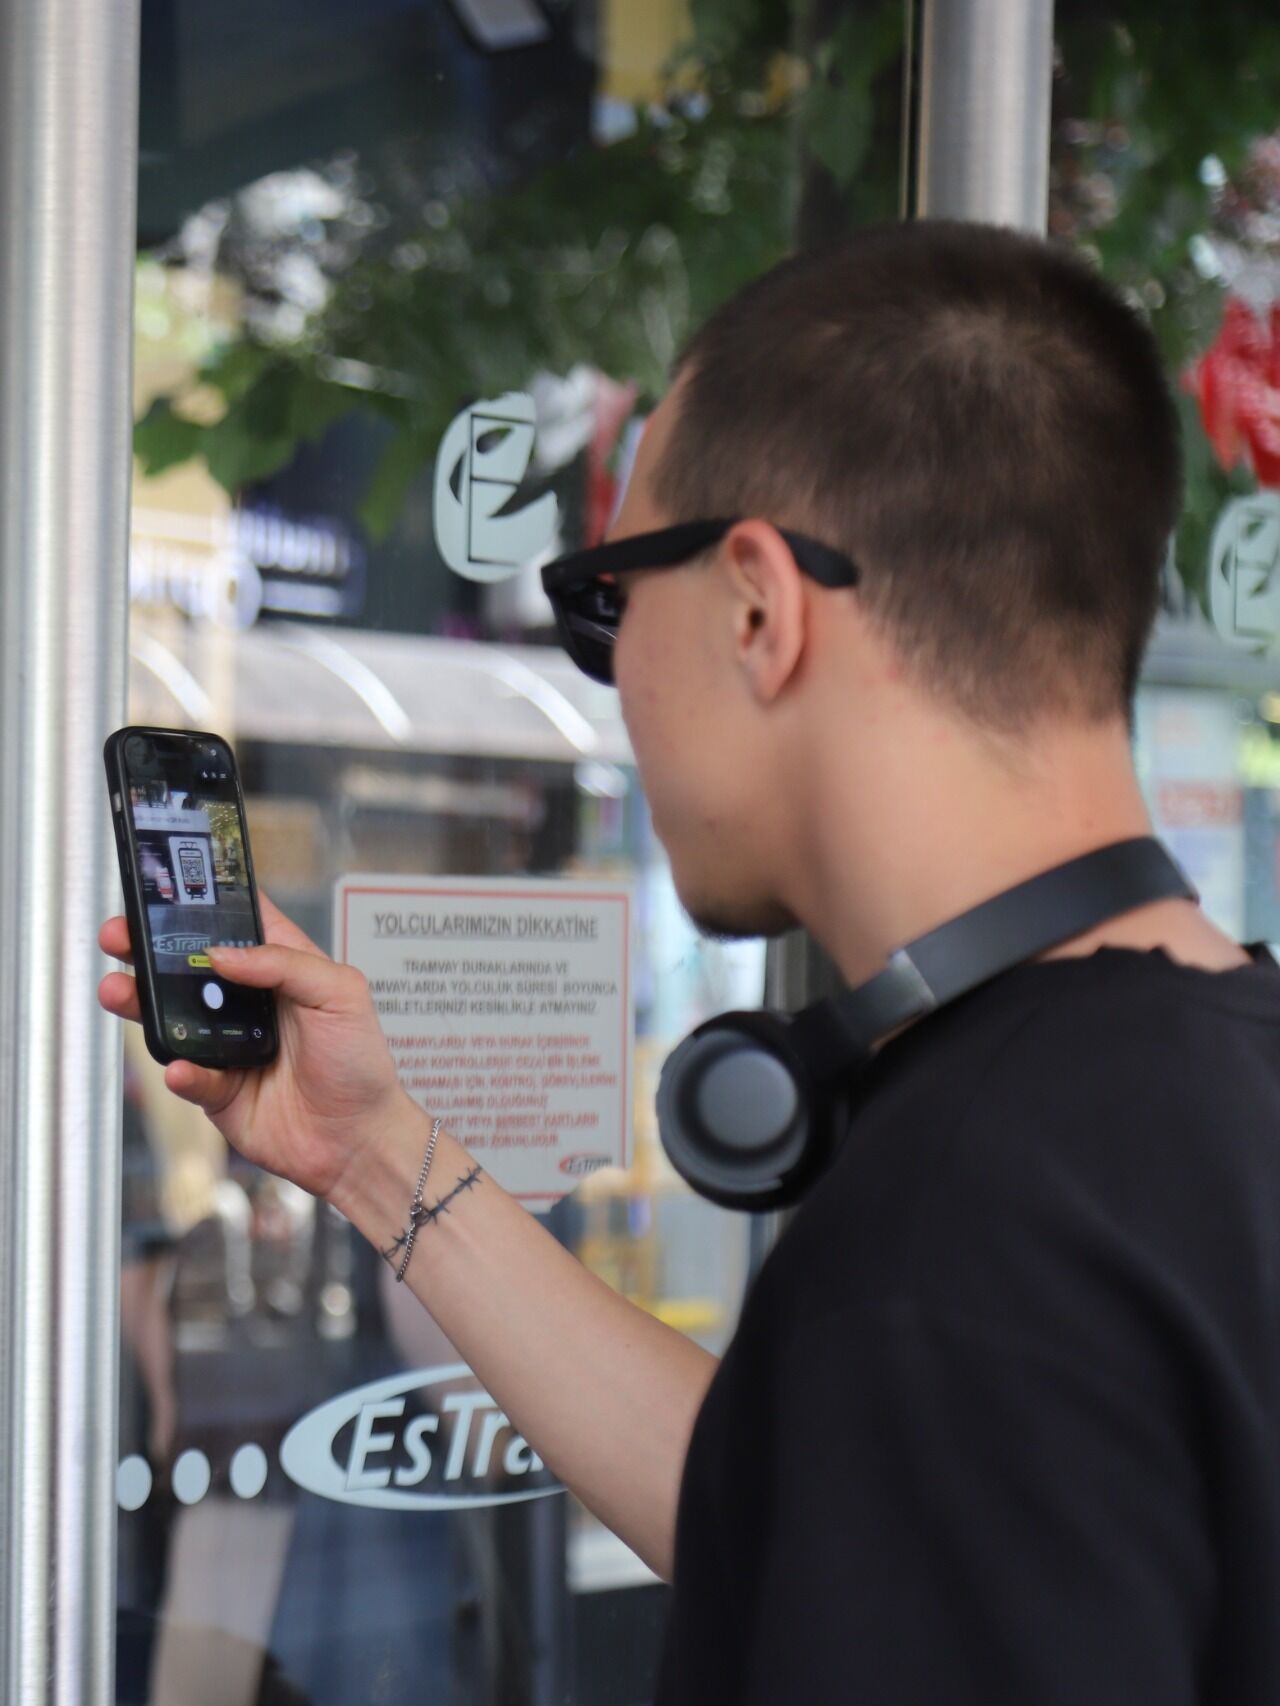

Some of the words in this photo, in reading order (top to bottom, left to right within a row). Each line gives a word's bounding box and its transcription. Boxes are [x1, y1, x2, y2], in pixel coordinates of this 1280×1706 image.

[373, 912, 513, 936] YOLCULARIMIZIN
[517, 913, 599, 938] DİKKATİNE
[368, 979, 448, 994] AMVAYLARDA
[344, 1391, 544, 1492] EsTra
